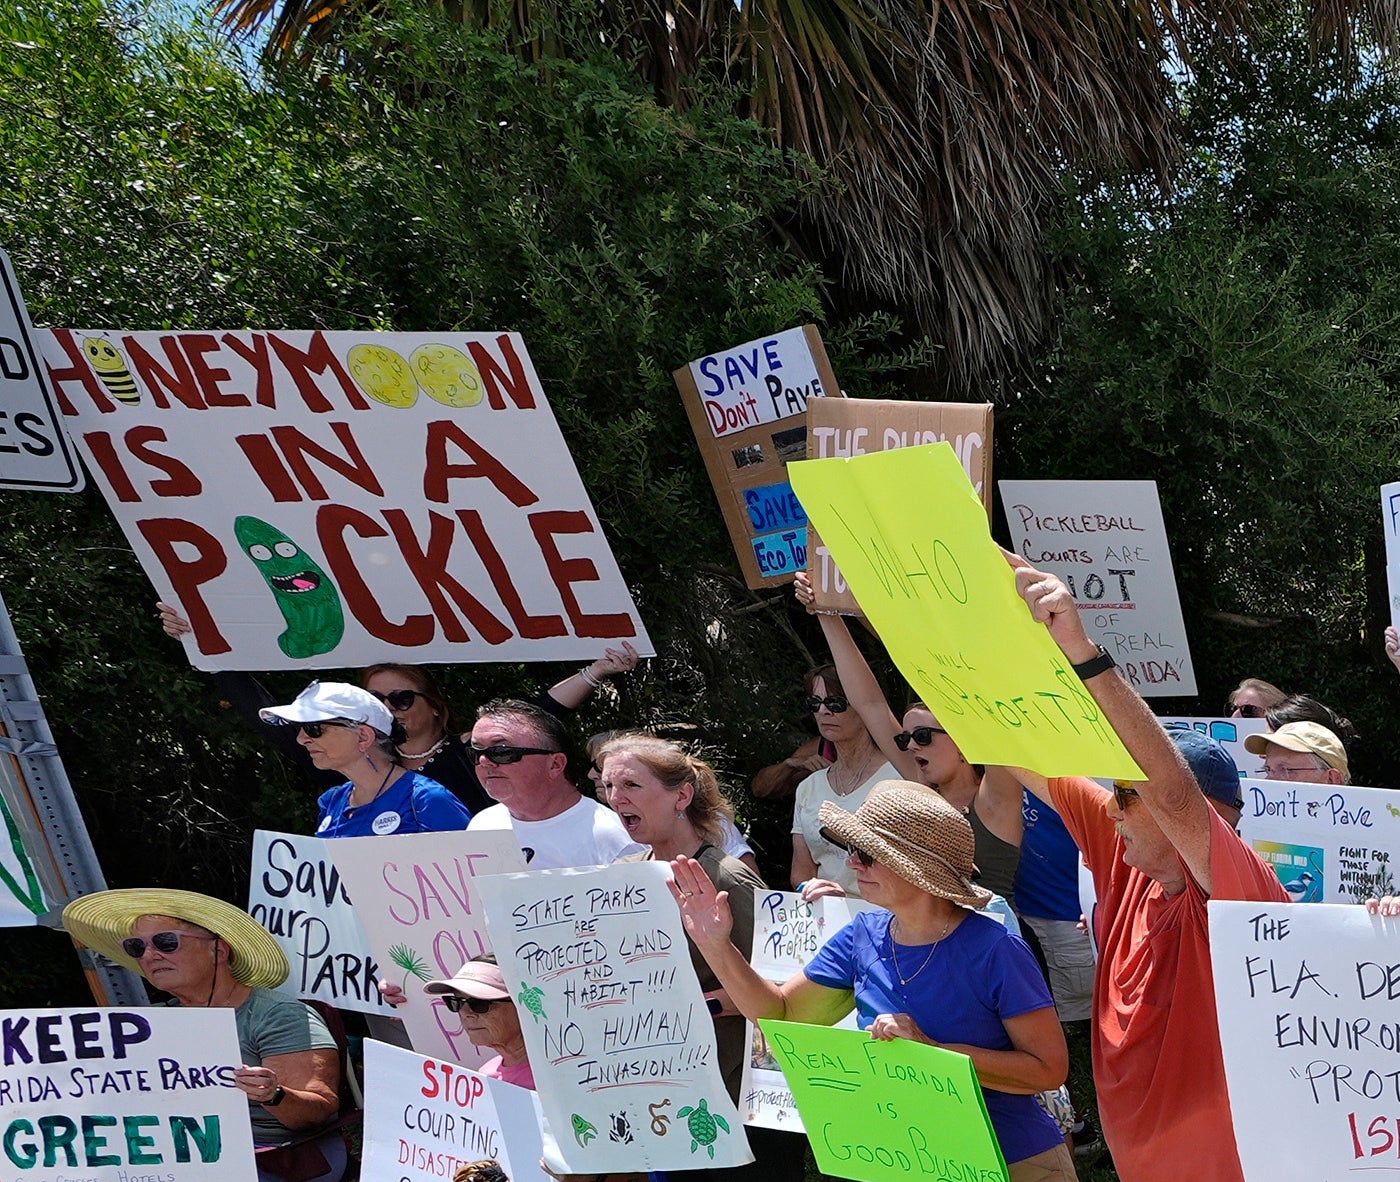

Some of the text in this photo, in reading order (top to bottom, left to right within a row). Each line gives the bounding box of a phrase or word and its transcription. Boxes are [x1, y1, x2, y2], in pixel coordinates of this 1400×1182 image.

[699, 340, 783, 397] SAVE
[83, 424, 202, 502] IS
[235, 421, 385, 502] IN
[423, 420, 540, 505] A
[1012, 504, 1147, 534] PICKLEBALL
[829, 504, 969, 606] WHO
[1022, 538, 1150, 564] COURTS ARE
[1094, 613, 1121, 628] OF
[1249, 786, 1374, 828] Don't Pave
[1338, 859, 1370, 872] THOSE
[1339, 846, 1390, 863] FIGHT FOR
[1340, 871, 1381, 885] WITHOUT
[511, 884, 648, 928] STATE PARKS
[573, 917, 598, 934] ARE
[761, 891, 815, 924] Parks
[764, 930, 818, 960] Profits
[780, 918, 811, 936] over
[1248, 912, 1291, 942] THE
[515, 938, 609, 976] PROTECTED
[619, 929, 672, 957] LAND
[583, 963, 614, 981] AND
[1244, 956, 1338, 1000] FLA.
[1, 1012, 152, 1066] KEEP
[543, 1003, 694, 1061] NO HUMAN
[69, 1057, 239, 1098] STATE PARKS
[420, 1061, 484, 1110] STOP
[773, 1032, 964, 1105] REAL FLORIDA
[876, 1102, 898, 1120] IS
[3, 1114, 223, 1170] GREEN
[404, 1104, 499, 1160] COURTING
[822, 1122, 912, 1173] GOOD
